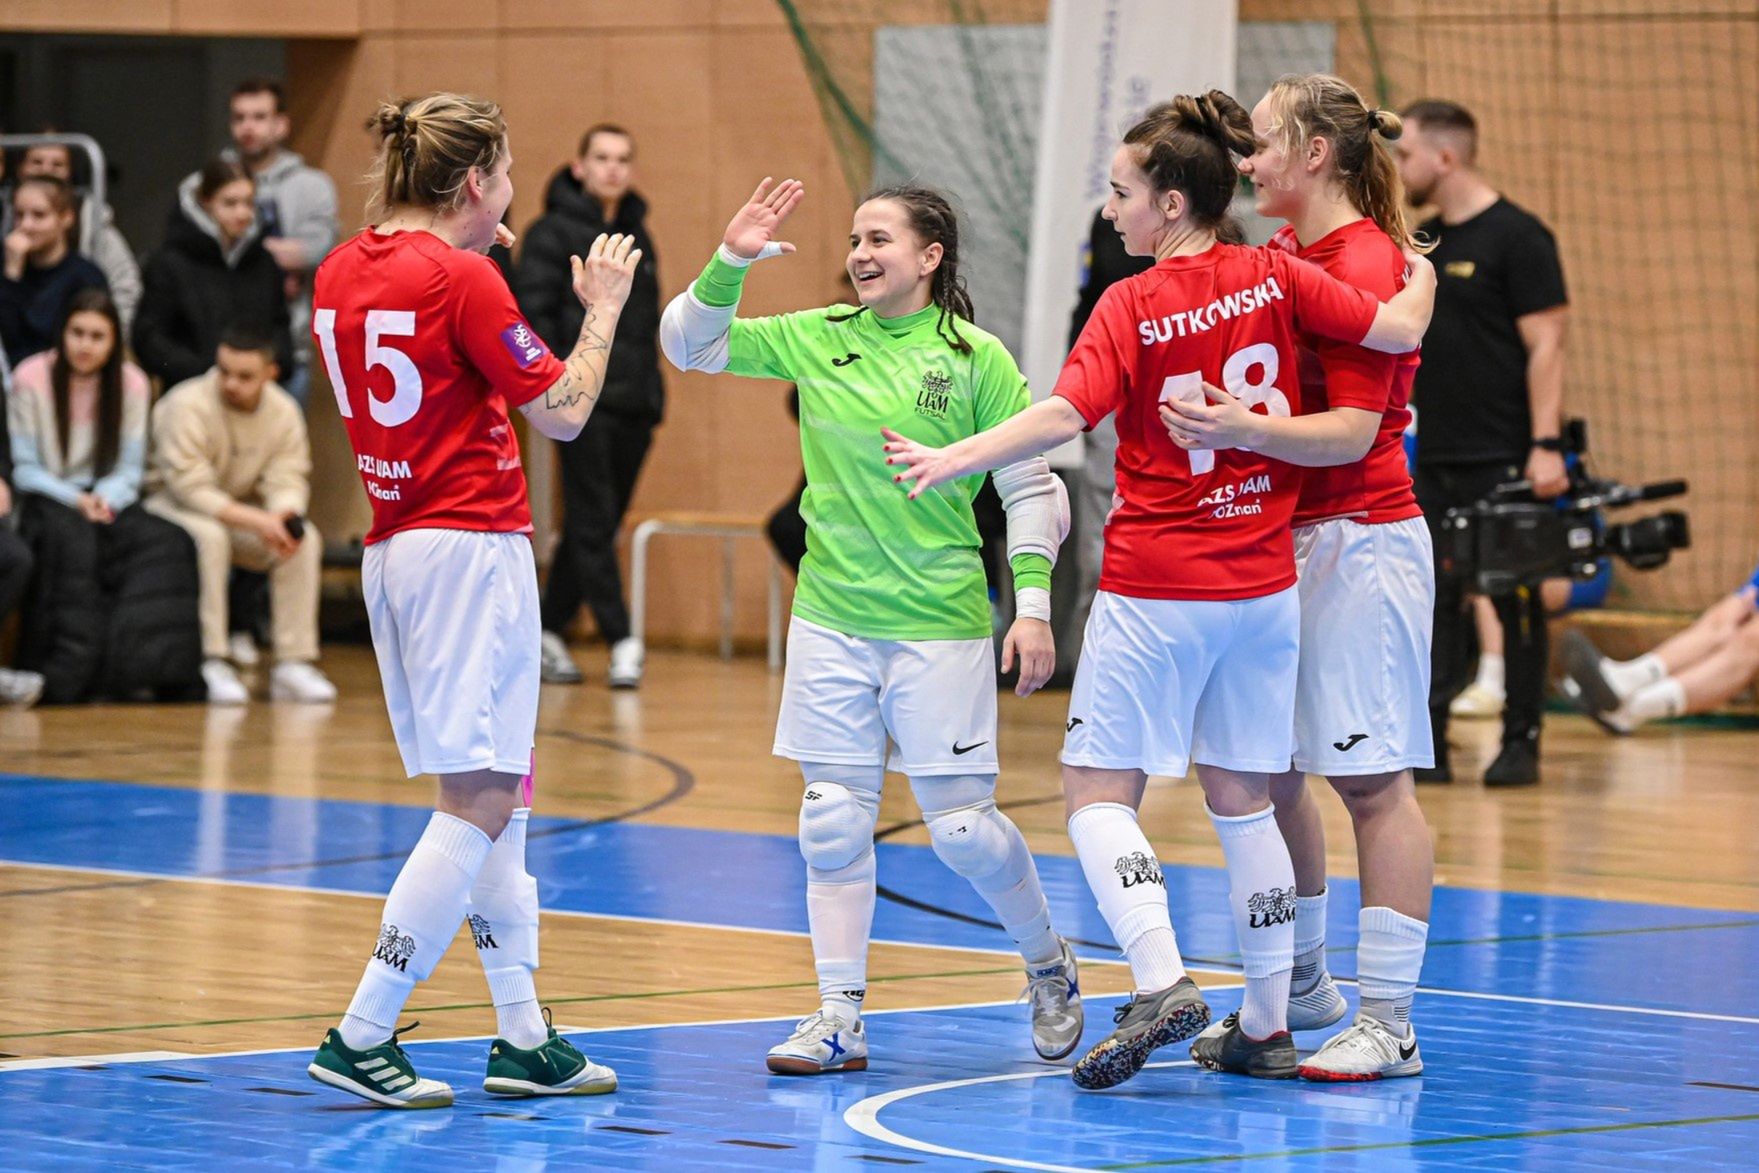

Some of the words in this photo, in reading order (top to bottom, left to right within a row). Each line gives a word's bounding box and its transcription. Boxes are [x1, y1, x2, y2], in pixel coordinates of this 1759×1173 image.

[1138, 276, 1284, 346] SUTKOWSKA
[314, 308, 423, 427] 15
[916, 390, 949, 413] UAM
[1158, 343, 1291, 476] 18
[1208, 498, 1262, 519] OZnań
[1249, 906, 1295, 928] UAM
